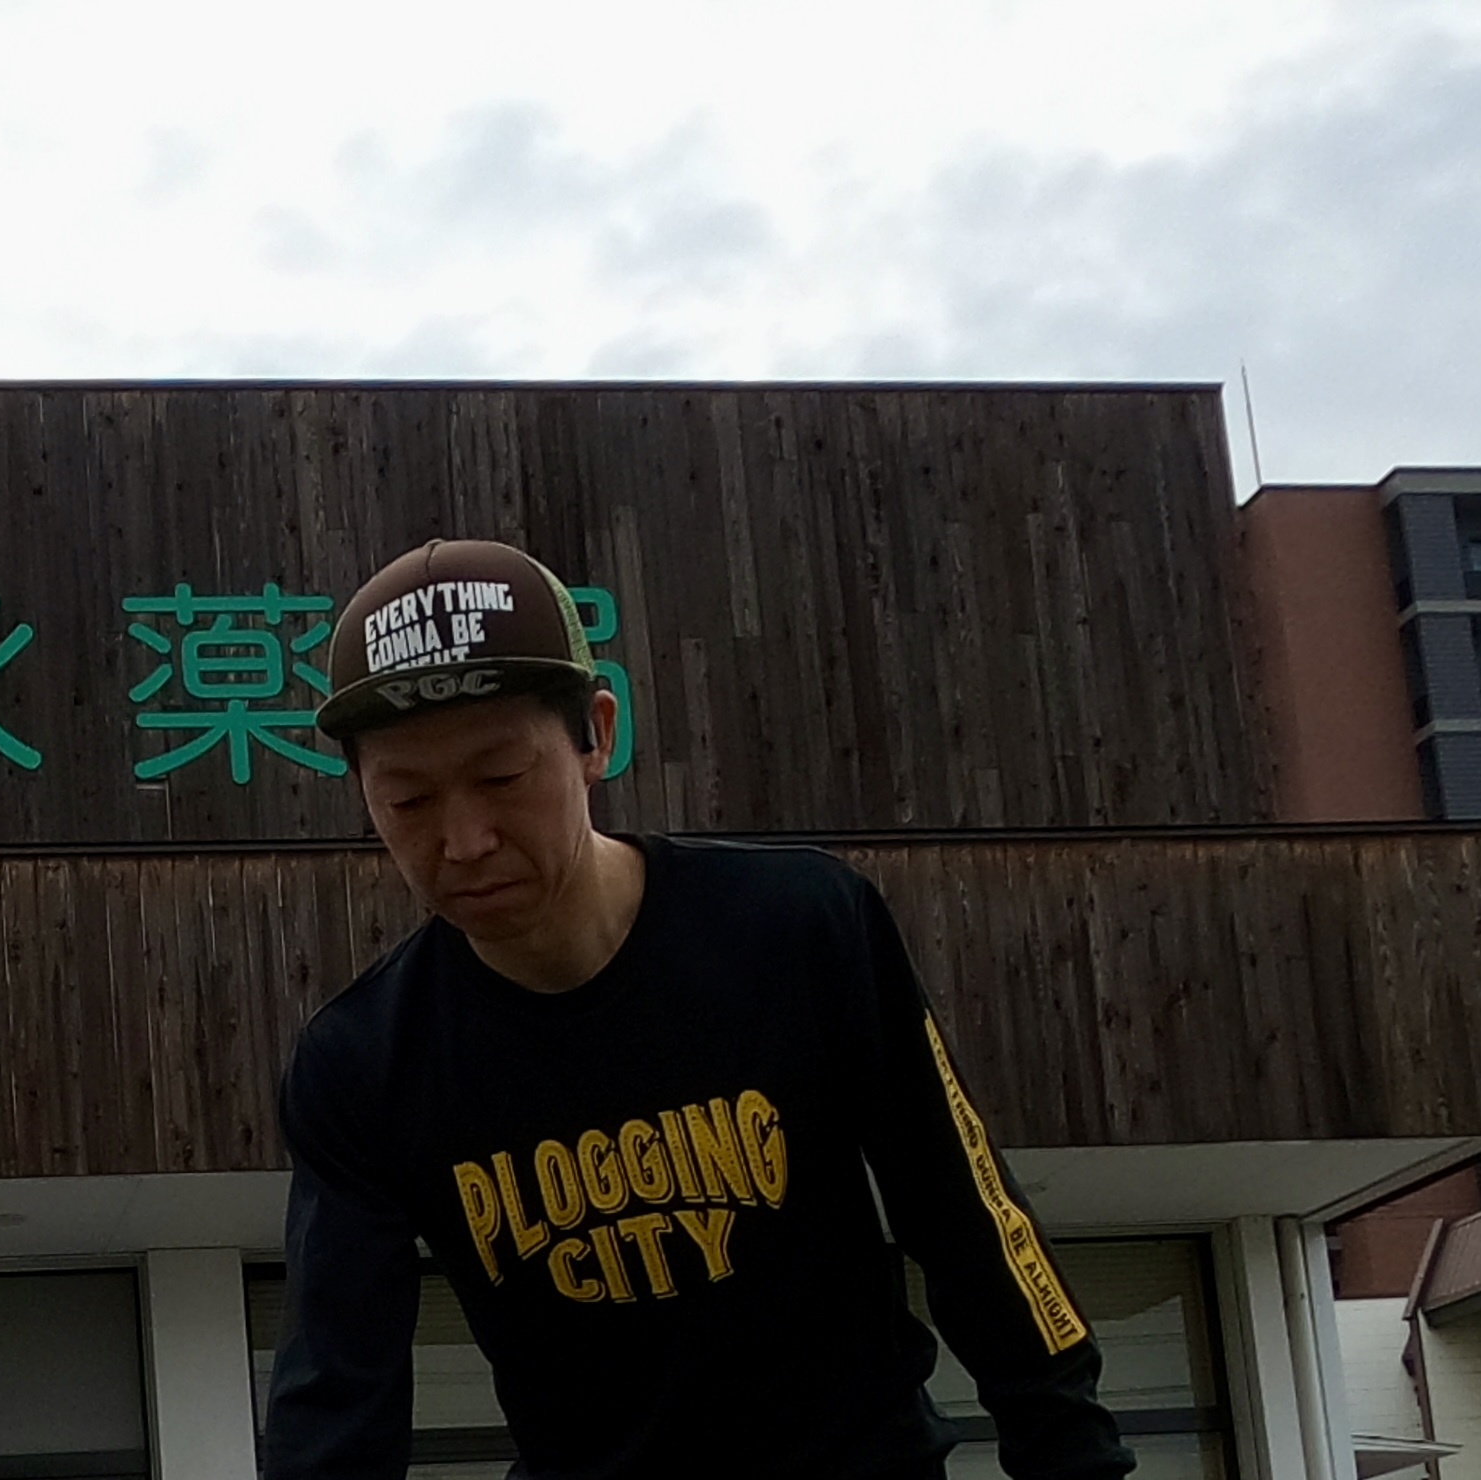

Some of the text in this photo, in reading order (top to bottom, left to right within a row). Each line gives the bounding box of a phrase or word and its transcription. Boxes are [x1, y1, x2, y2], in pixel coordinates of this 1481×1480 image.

[364, 581, 514, 645] EVERYTHING
[366, 619, 442, 674] GONNA
[450, 611, 486, 646] BE
[375, 669, 505, 711] PGC
[453, 1089, 788, 1287] PLOGGING
[548, 1208, 736, 1303] CITY
[1009, 1226, 1032, 1254] BE
[1022, 1259, 1079, 1342] ALRIGHT
